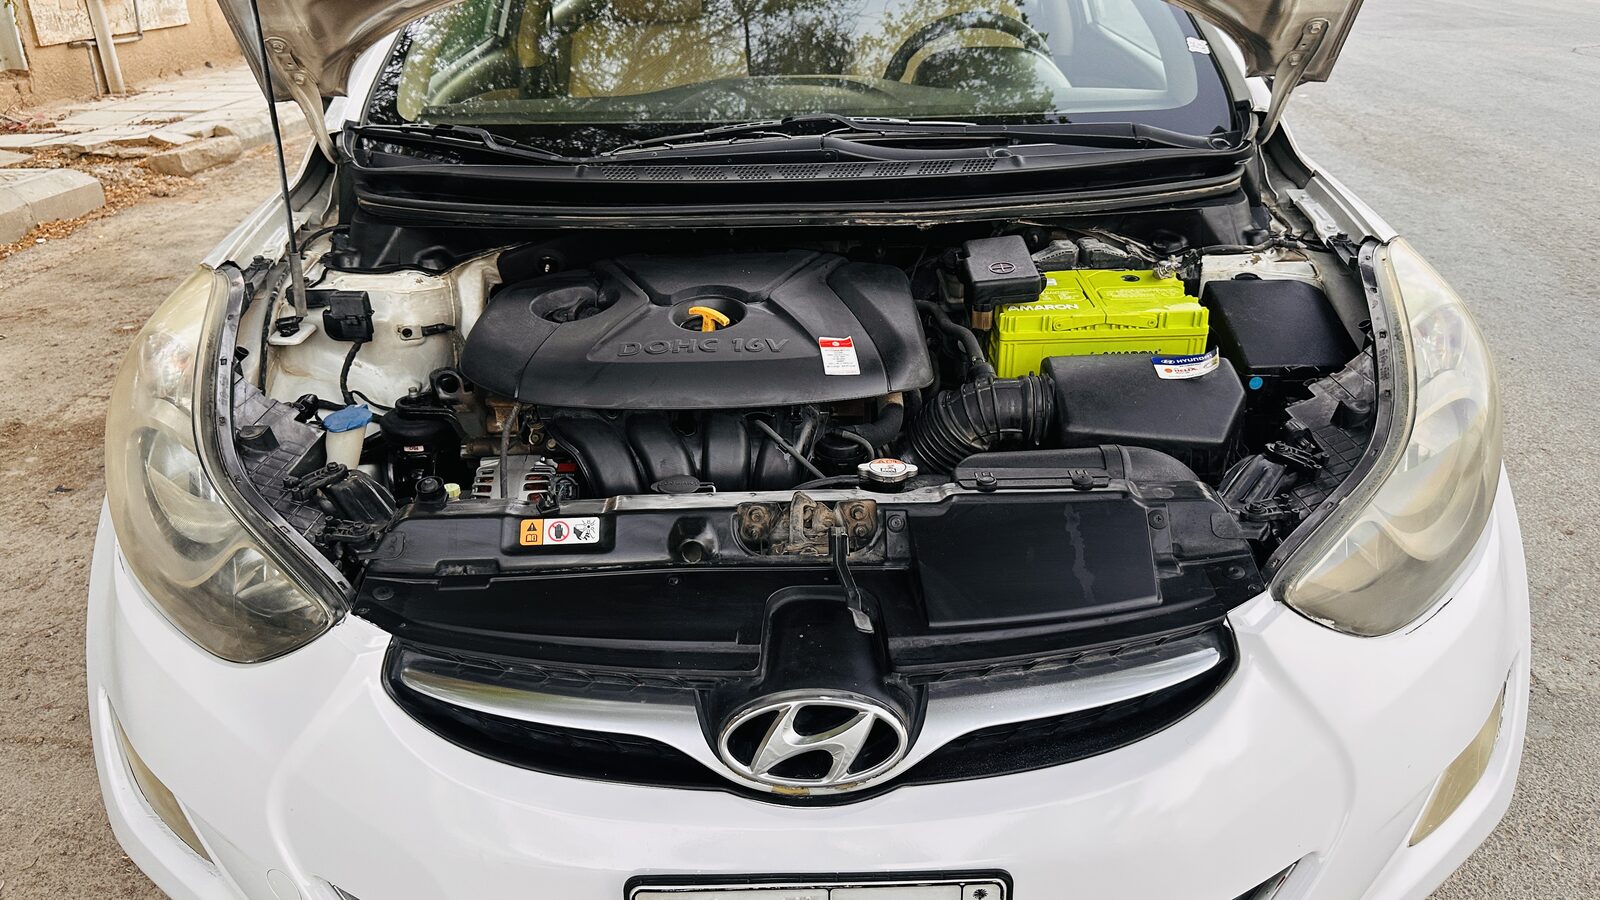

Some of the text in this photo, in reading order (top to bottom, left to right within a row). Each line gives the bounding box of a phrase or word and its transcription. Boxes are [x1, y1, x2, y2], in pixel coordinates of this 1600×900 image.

[1007, 303, 1079, 312] AMARON
[617, 338, 790, 357] DOHC 16V
[1176, 353, 1213, 364] HYUNDAI
